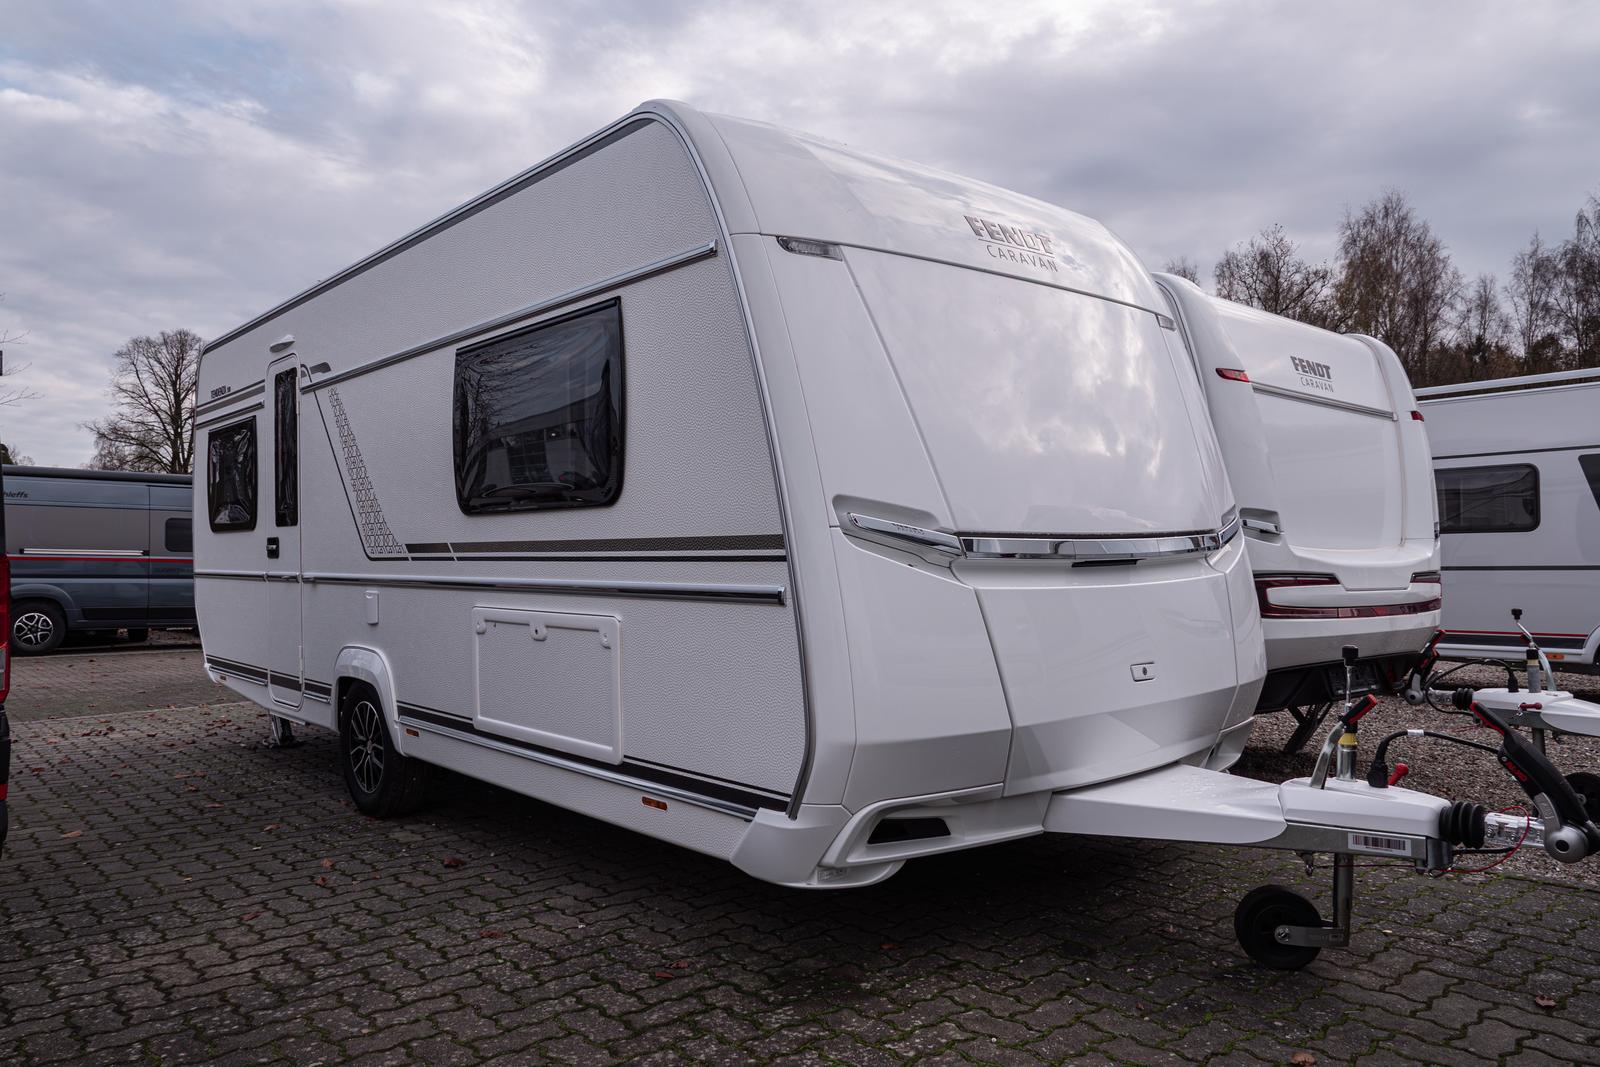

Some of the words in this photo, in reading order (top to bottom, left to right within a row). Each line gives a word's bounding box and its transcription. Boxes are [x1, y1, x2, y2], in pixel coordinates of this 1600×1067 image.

[963, 215, 1054, 255] FENDT
[986, 244, 1058, 272] CARAVAN
[1290, 355, 1331, 380] FENDT
[1300, 376, 1334, 392] CARAVAN
